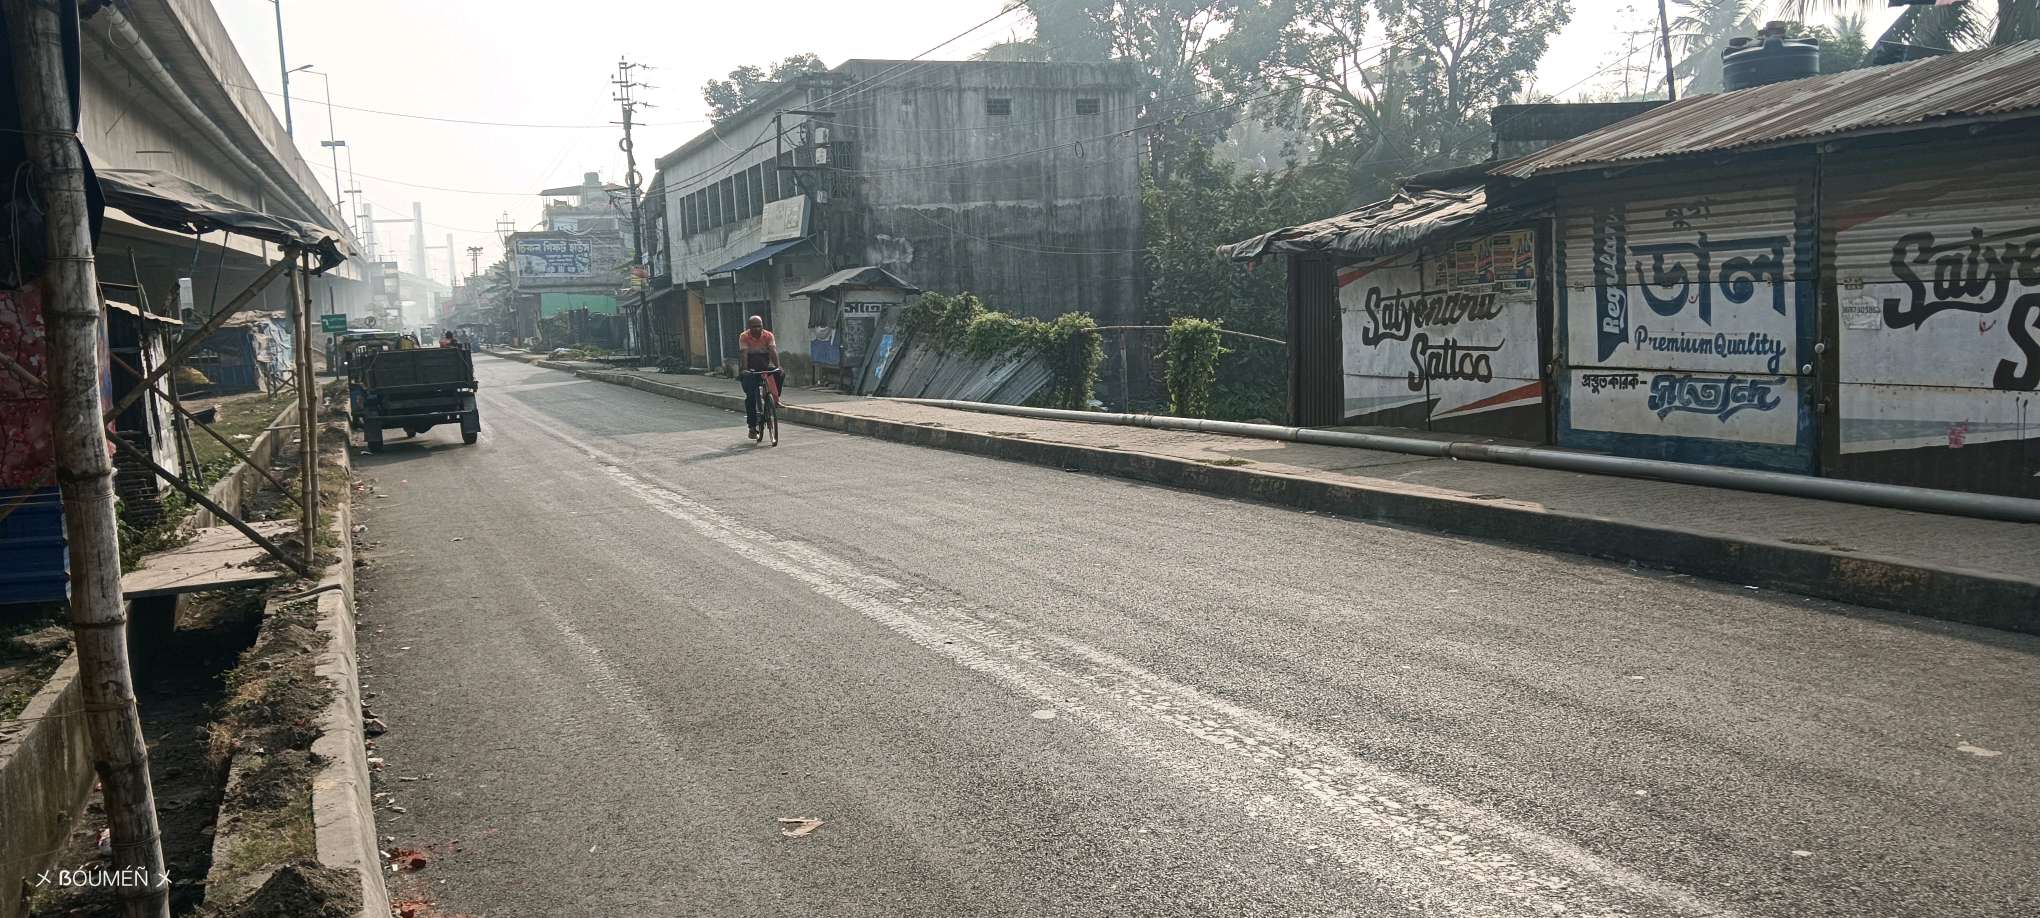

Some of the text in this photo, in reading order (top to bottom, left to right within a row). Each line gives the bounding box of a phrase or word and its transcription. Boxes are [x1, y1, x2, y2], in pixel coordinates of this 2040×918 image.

[1627, 231, 1793, 326] ডাল
[1408, 333, 1505, 391] Sattoo
[1635, 325, 1786, 374] Premium Quality
